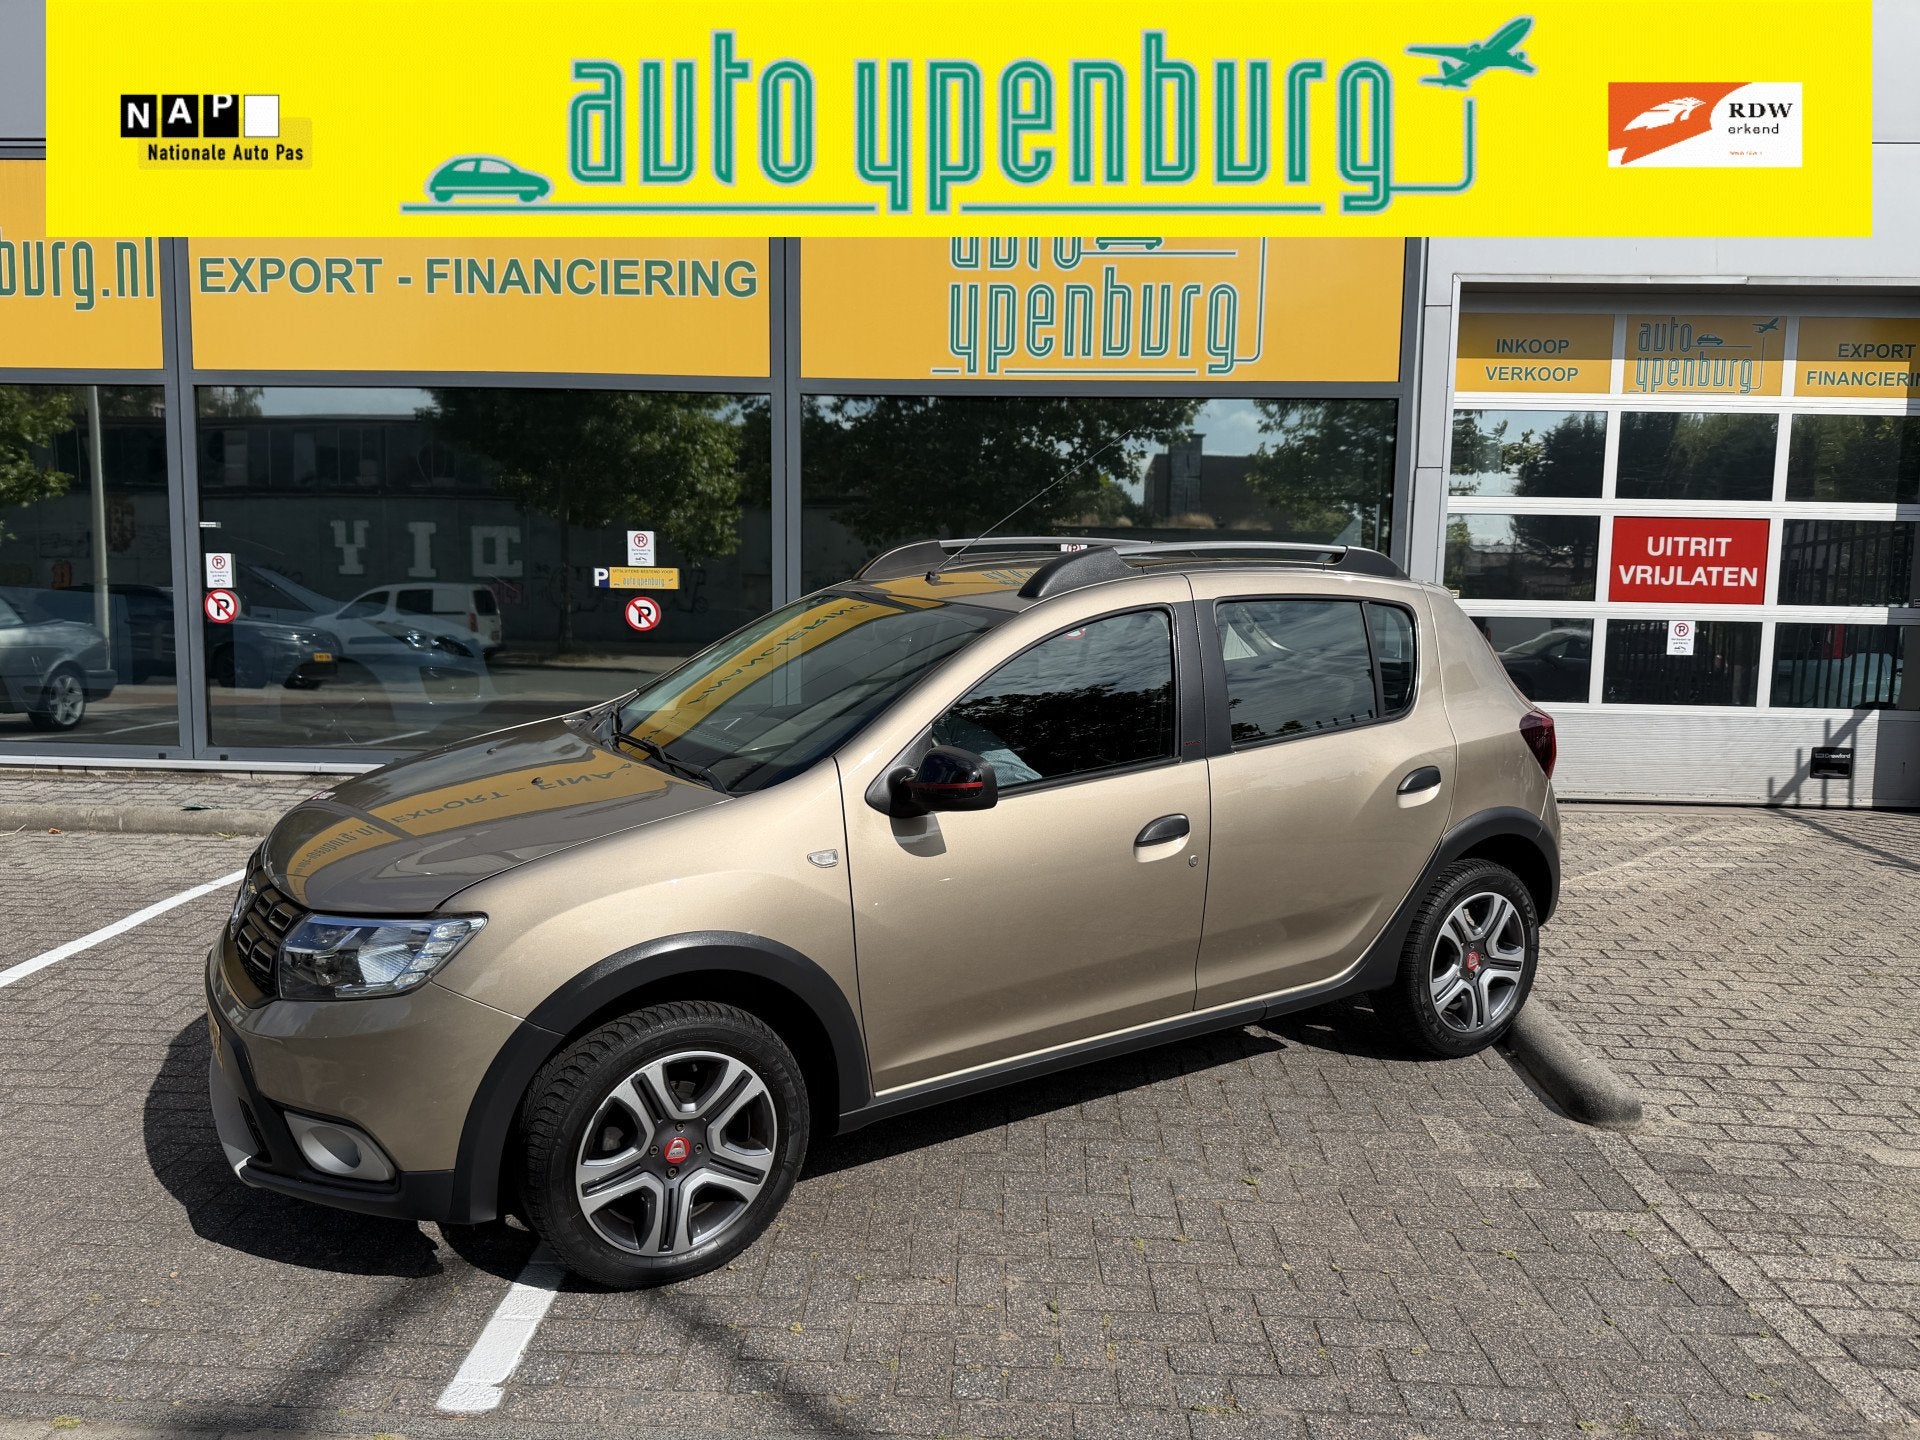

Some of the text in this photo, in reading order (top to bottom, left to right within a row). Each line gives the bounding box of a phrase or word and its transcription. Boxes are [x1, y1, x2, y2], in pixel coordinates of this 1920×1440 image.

[198, 256, 383, 294] EXPORT
[425, 257, 758, 299] FINANCIERING
[949, 265, 1239, 375] ypenburg
[1638, 316, 1692, 352] auto
[1496, 338, 1570, 354] INKOOP
[1838, 343, 1917, 359] EXPORT
[1485, 366, 1579, 382] VERKOOP
[1635, 351, 1753, 394] ypenburg
[1647, 536, 1732, 557] UITRIT
[1618, 564, 1758, 587] VRIJLATEN
